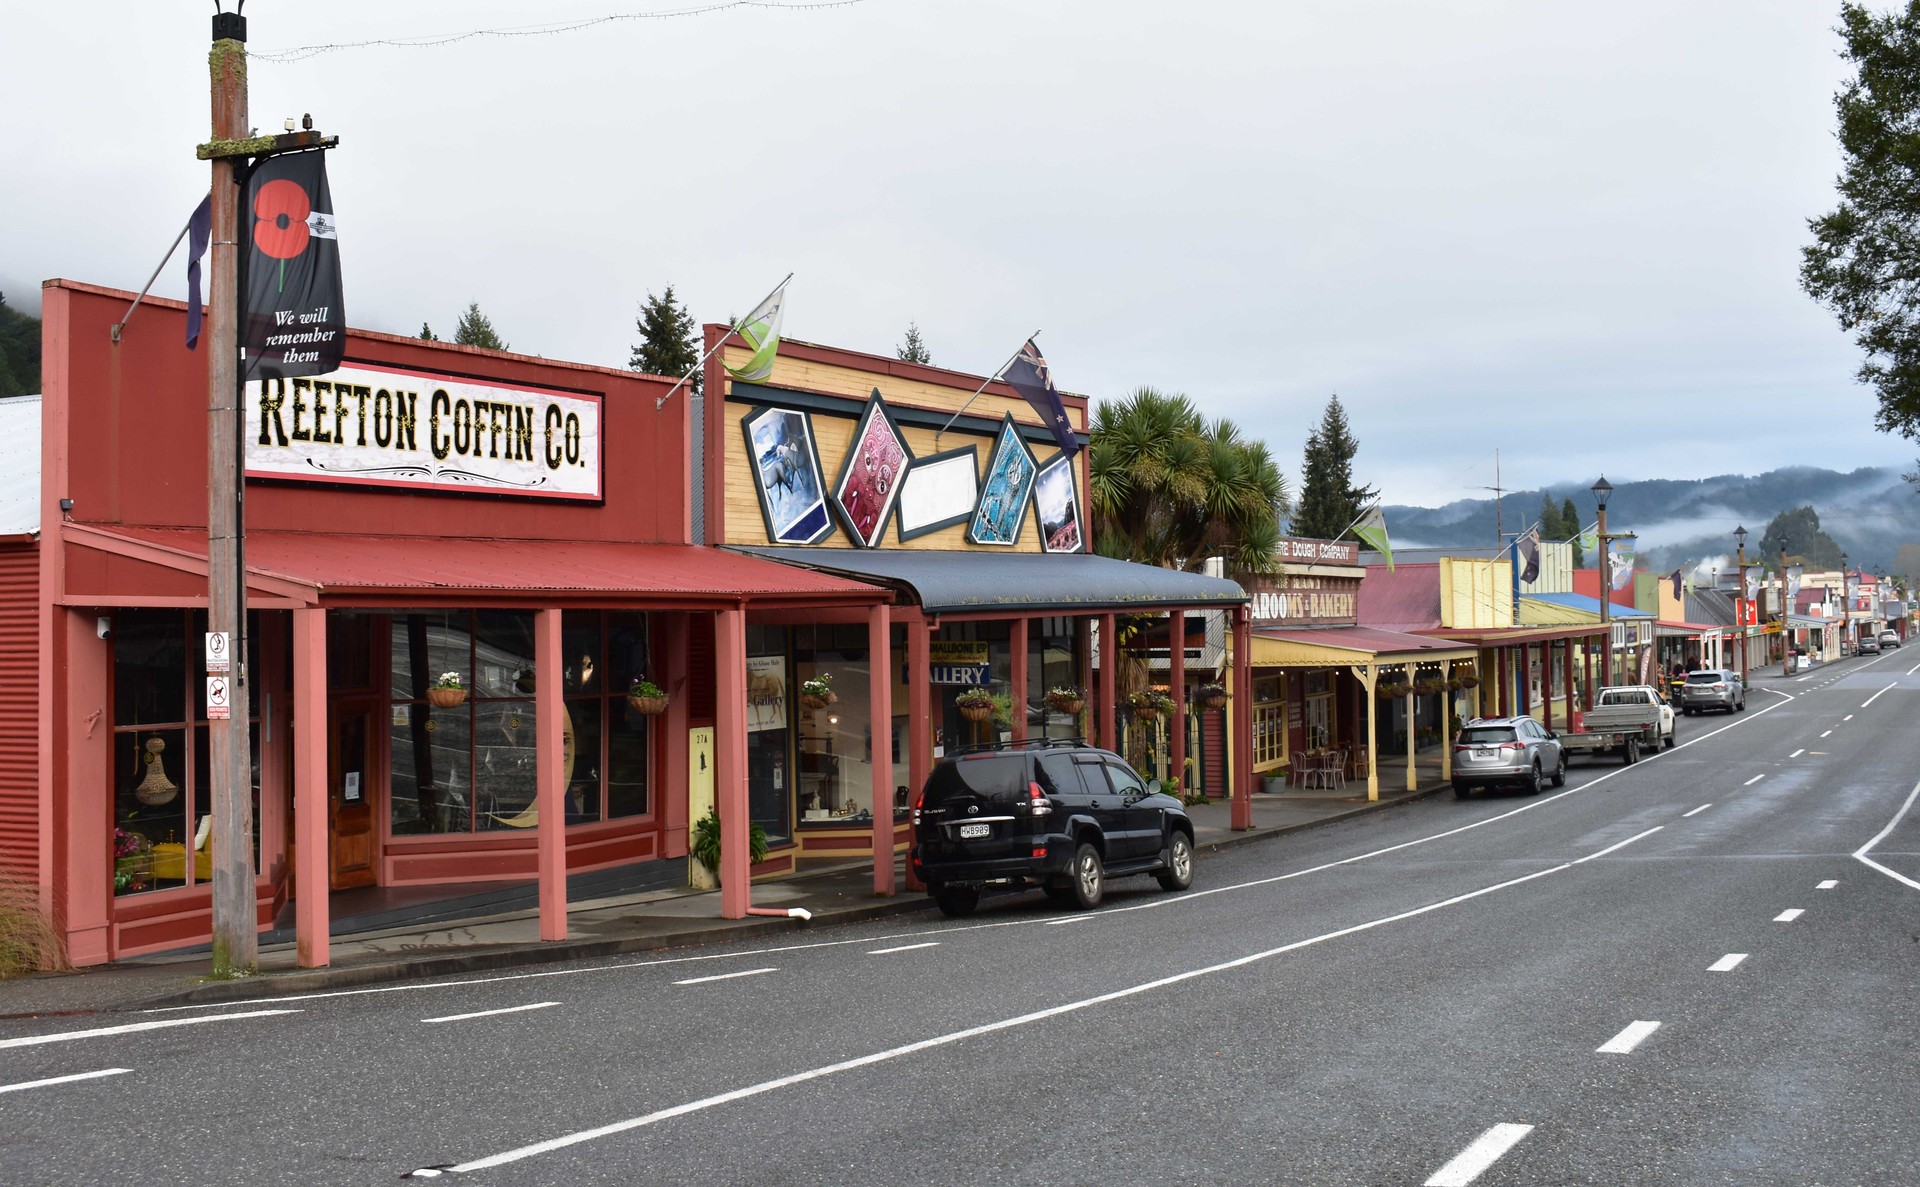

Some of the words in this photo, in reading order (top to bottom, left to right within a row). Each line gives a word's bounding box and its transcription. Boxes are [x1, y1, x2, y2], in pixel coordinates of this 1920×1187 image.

[275, 311, 294, 326] We
[299, 307, 328, 323] will
[265, 329, 336, 347] remember
[282, 349, 320, 364] them
[258, 376, 417, 450] REEFTON
[430, 388, 535, 462] COFFIN
[544, 403, 586, 470] CO.
[1292, 541, 1316, 558] DOUGH
[1319, 543, 1350, 560] COMPANY
[1251, 593, 1303, 619] AROOMS
[1310, 593, 1354, 618] BAKERY
[929, 667, 985, 684] ALLERY
[753, 693, 784, 707] Gallery
